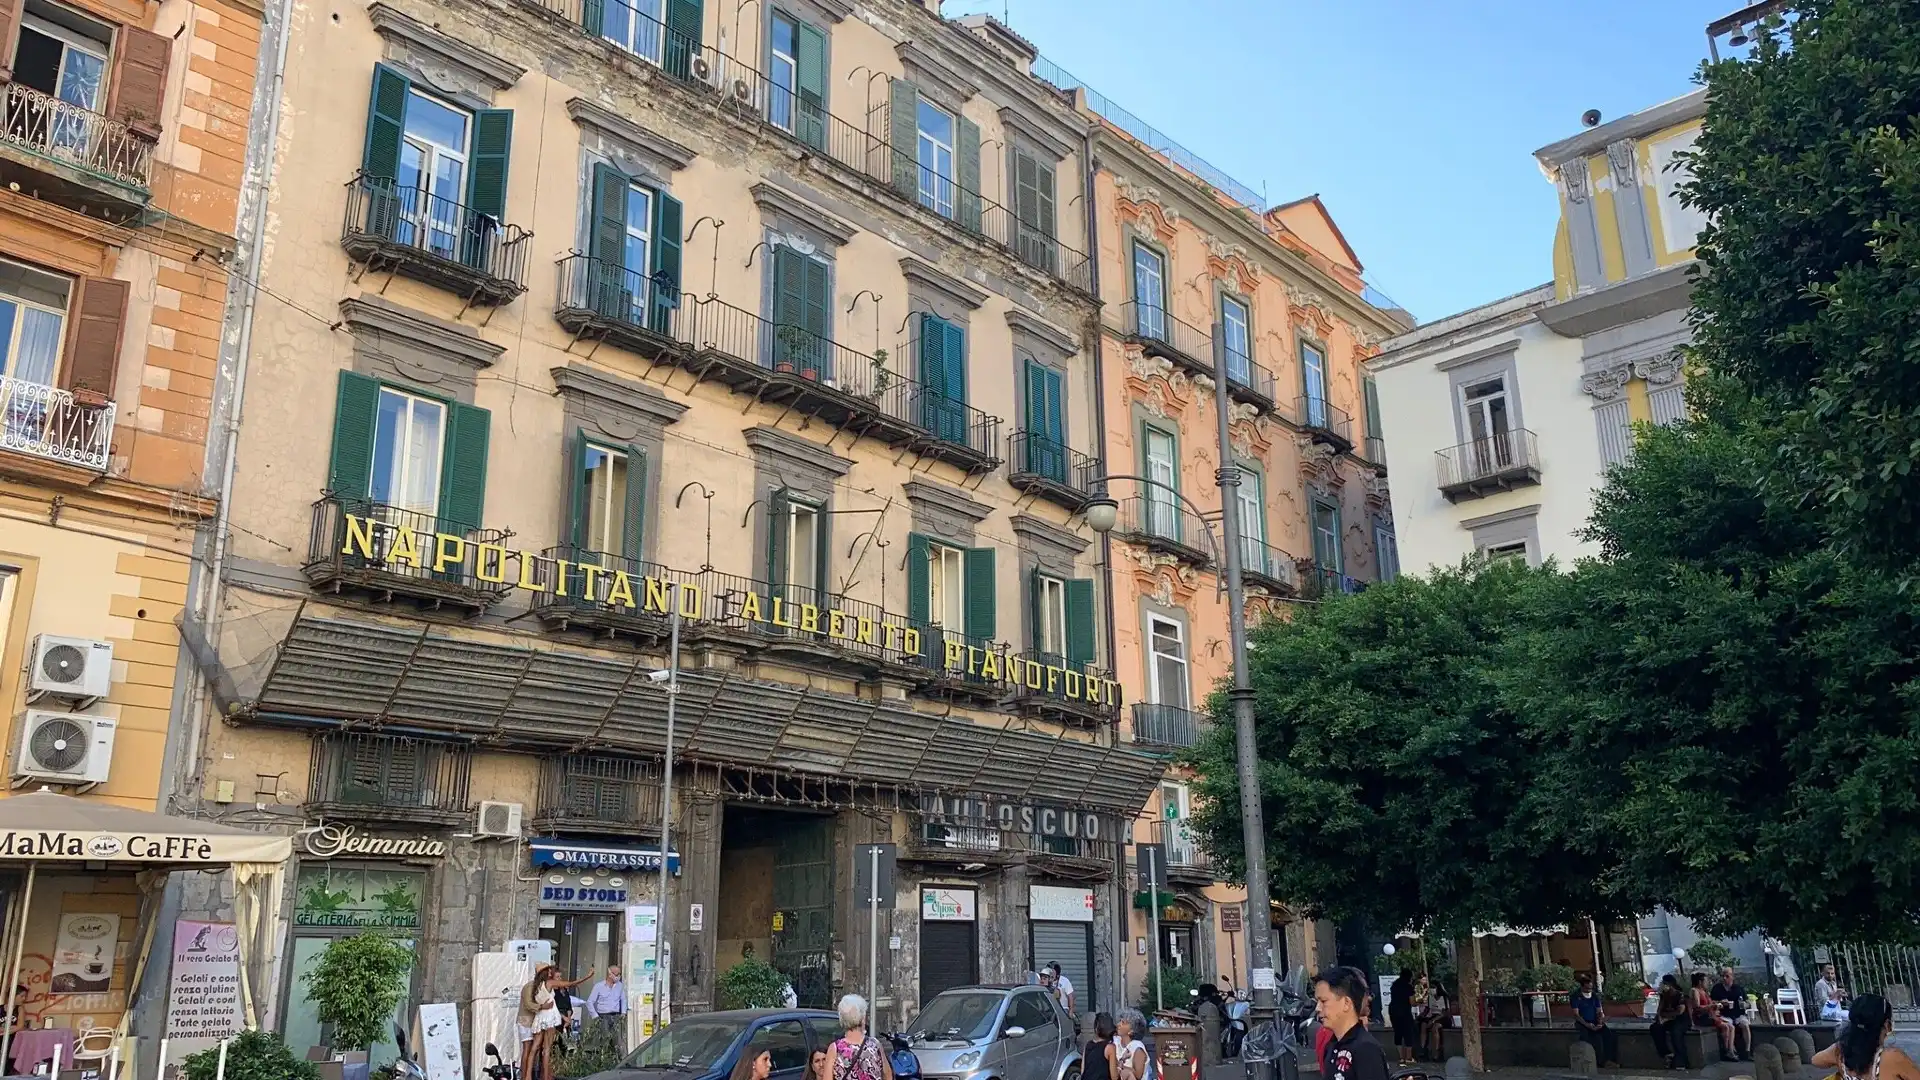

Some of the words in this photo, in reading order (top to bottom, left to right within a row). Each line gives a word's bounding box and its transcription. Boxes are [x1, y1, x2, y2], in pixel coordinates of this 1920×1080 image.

[342, 513, 701, 620] NAPOLITANO
[741, 591, 920, 656] ALBERTO
[931, 796, 1133, 845] AUTOSCUOA
[305, 821, 446, 857] Scimmia
[127, 835, 212, 859] CaFFè
[565, 851, 651, 866] MATERASSI
[543, 887, 575, 900] BED
[578, 888, 627, 902] STORE
[297, 913, 353, 926] GELATERIA
[379, 915, 417, 926] SCIMMIA
[205, 954, 232, 963] Gelato
[180, 974, 208, 983] Gelati
[210, 975, 217, 983] e
[219, 974, 239, 983] coni
[174, 986, 201, 994] senza
[203, 985, 236, 996] glutine
[177, 995, 206, 1005] Gelati
[216, 996, 236, 1004] coni
[171, 1008, 198, 1016] senza
[200, 1006, 235, 1015] lattosio
[174, 1018, 199, 1027] Torte
[201, 1017, 231, 1029] gelato
[168, 1028, 237, 1040] personalizzate
